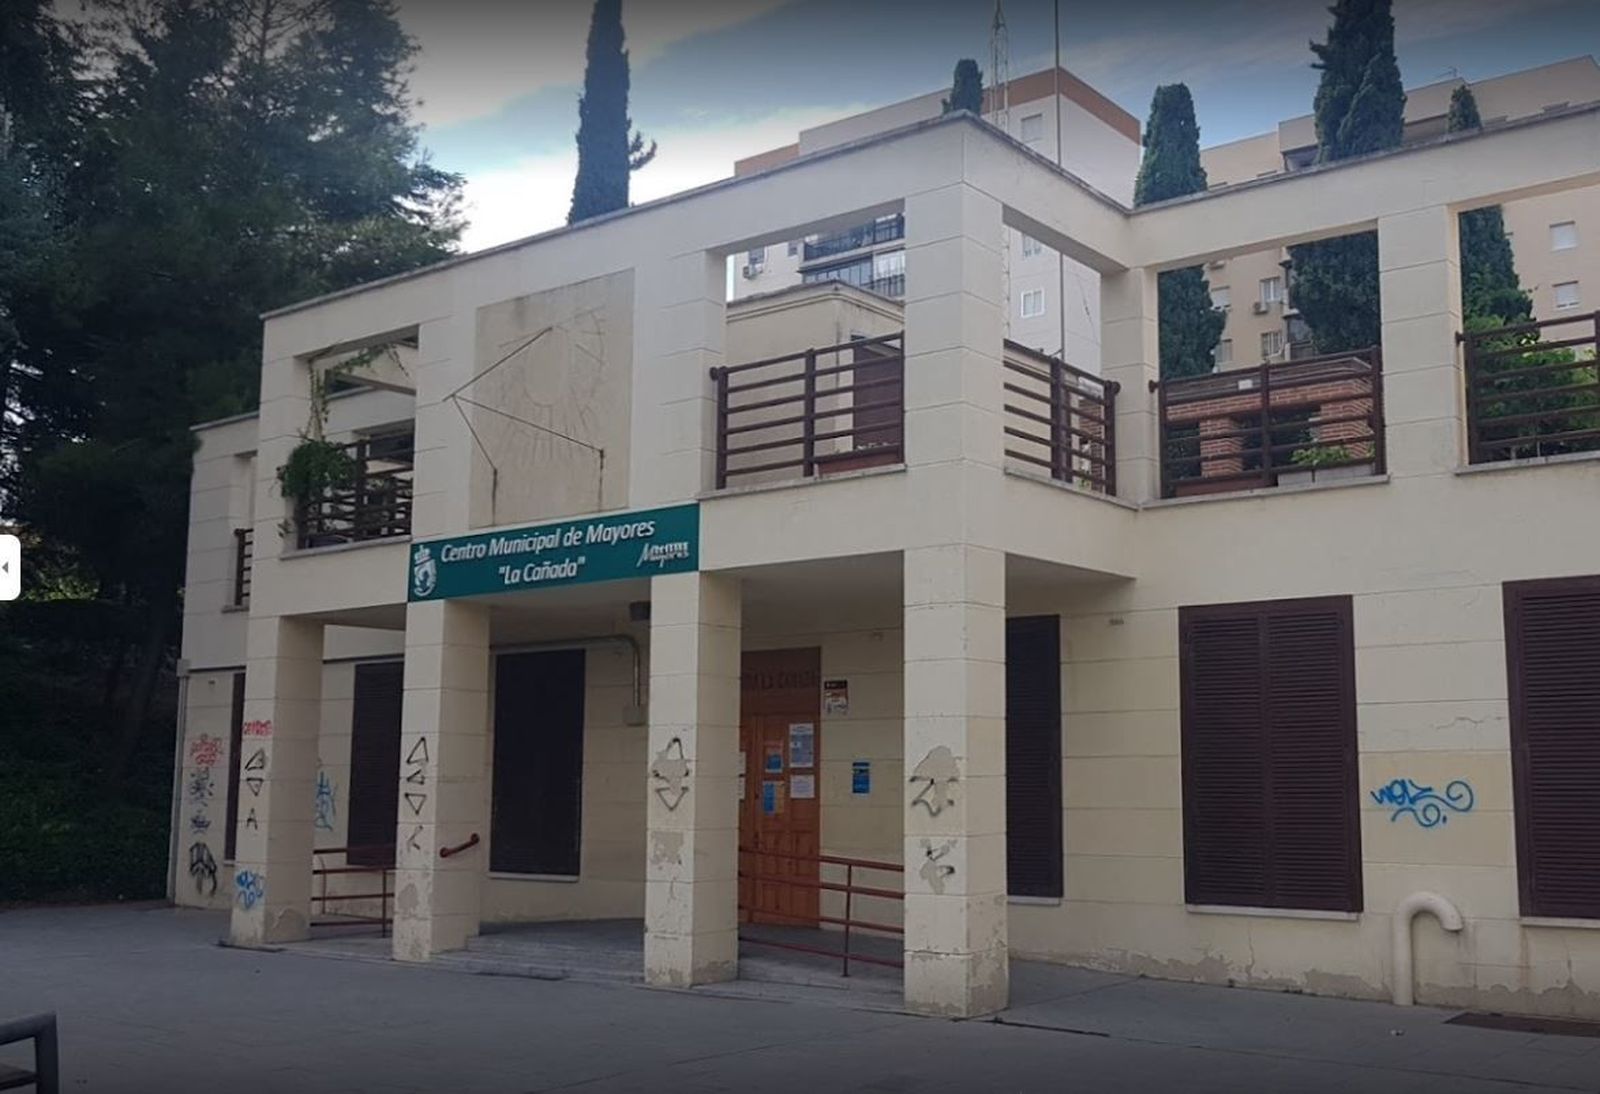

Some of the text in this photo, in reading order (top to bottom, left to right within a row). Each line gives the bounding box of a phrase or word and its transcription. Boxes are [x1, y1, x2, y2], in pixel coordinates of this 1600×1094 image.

[441, 520, 656, 562] Centro Municipal de Mayores
[499, 556, 586, 585] "La Cañada"
